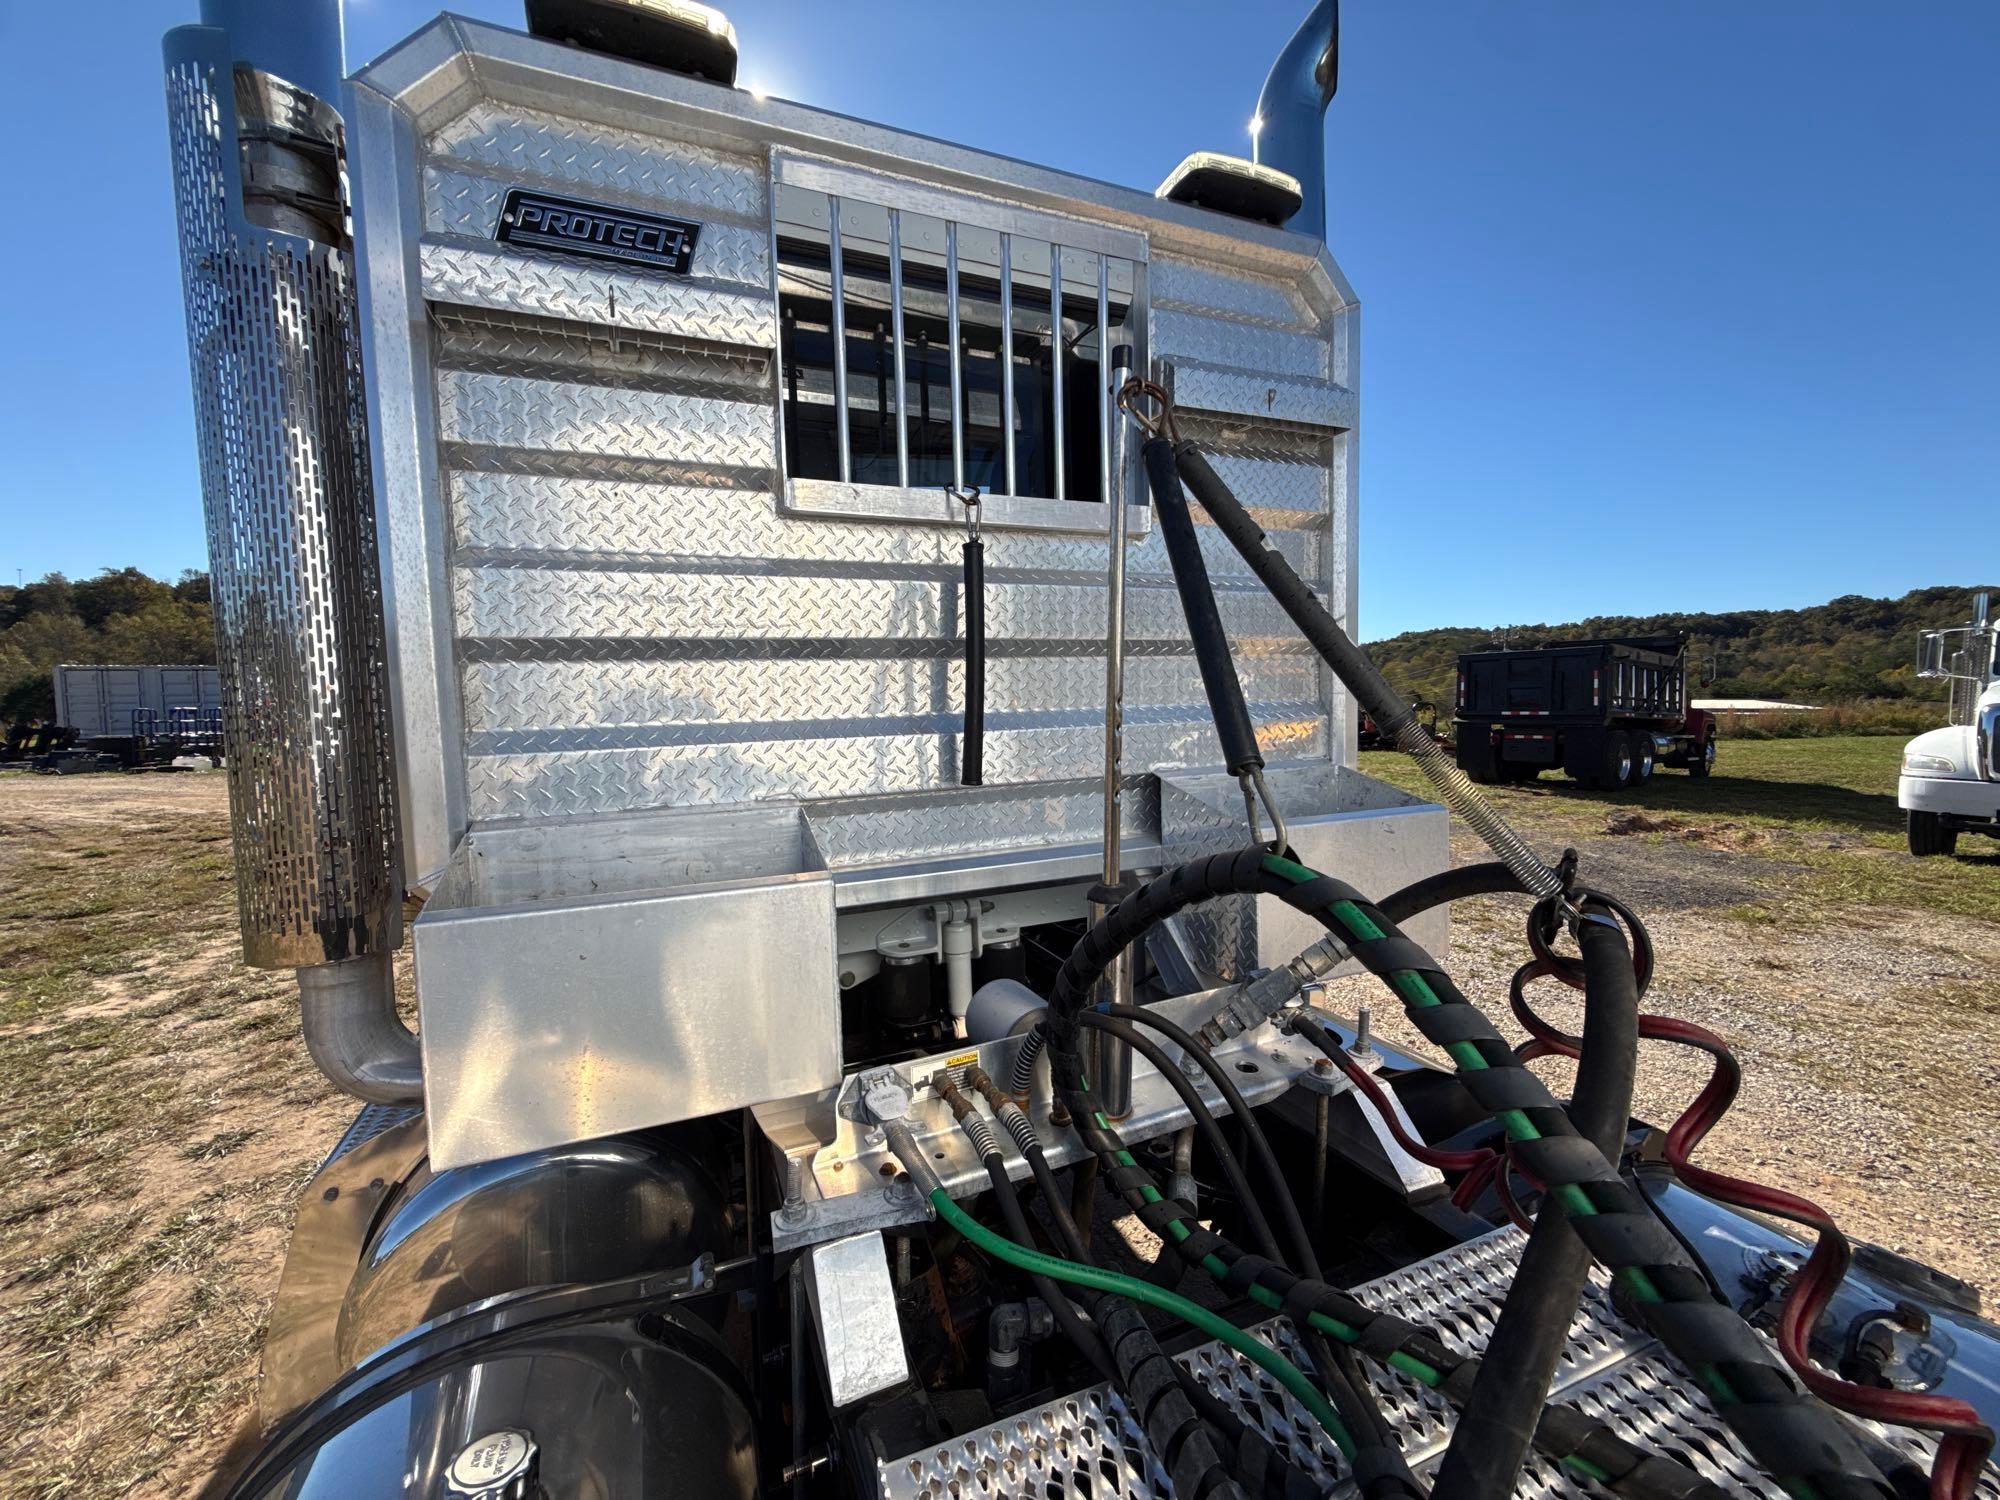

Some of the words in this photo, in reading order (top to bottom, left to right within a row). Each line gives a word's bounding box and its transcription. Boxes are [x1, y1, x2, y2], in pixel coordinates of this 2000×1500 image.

[514, 204, 684, 255] PROTECH
[951, 1053, 977, 1064] CAUTION
[470, 1448, 485, 1468] ONLY
